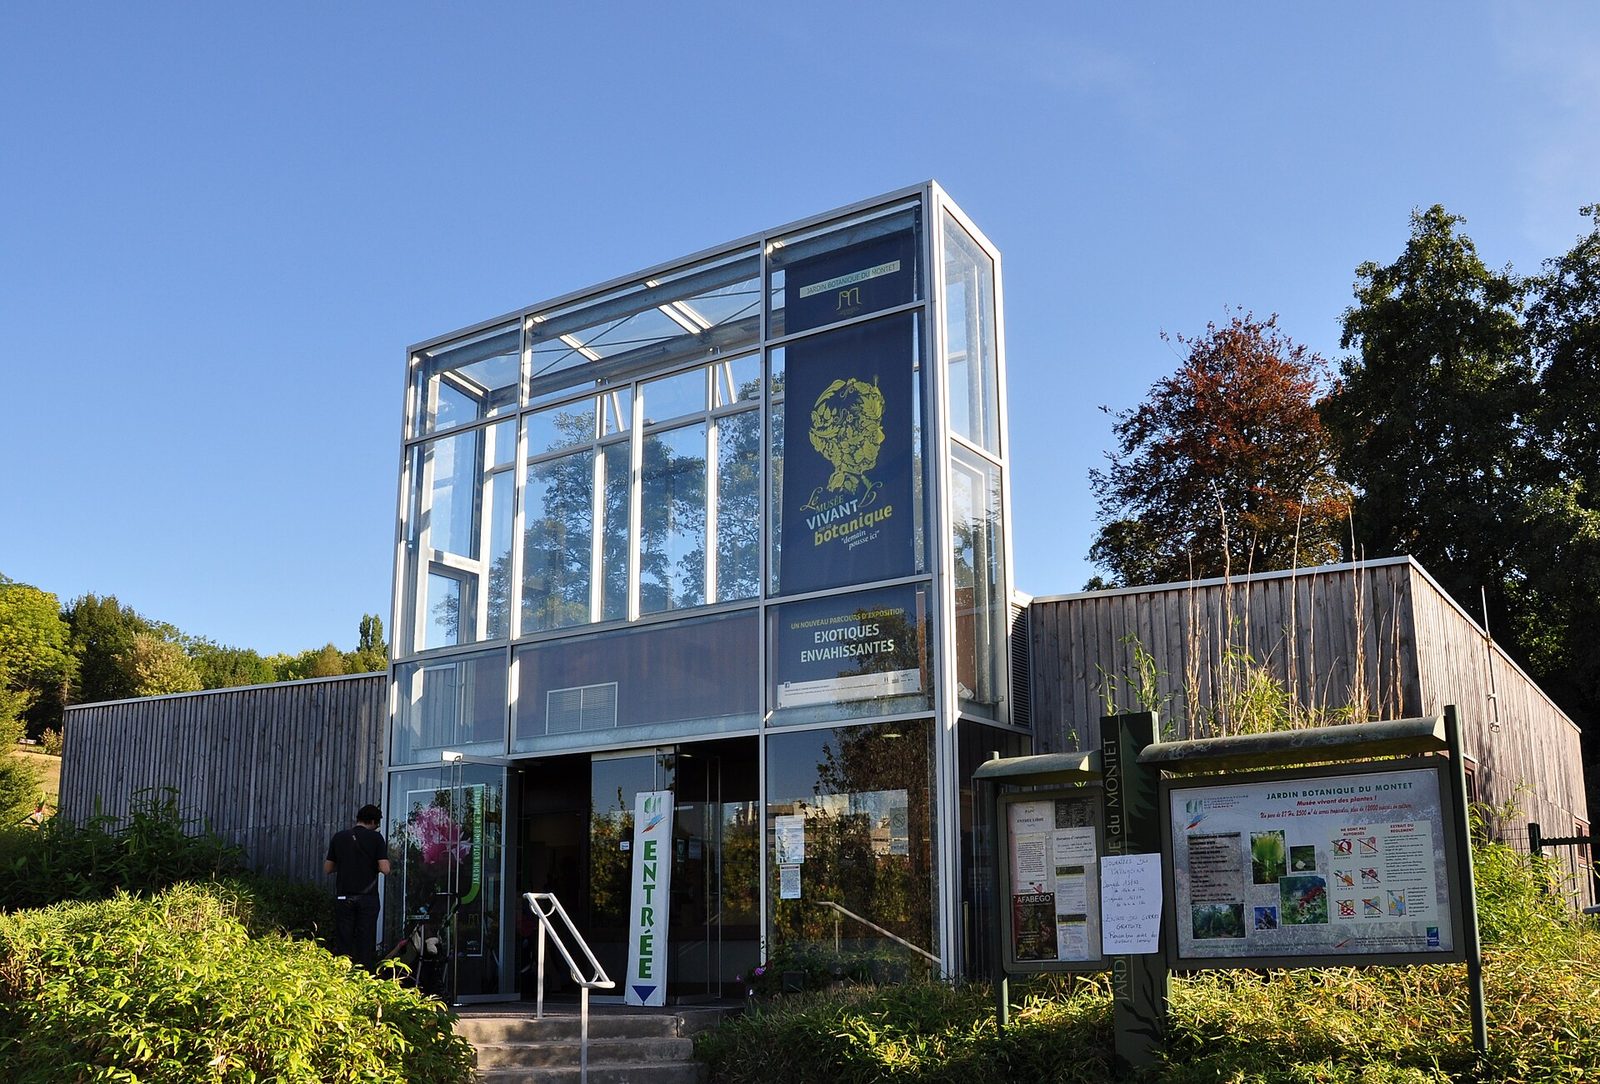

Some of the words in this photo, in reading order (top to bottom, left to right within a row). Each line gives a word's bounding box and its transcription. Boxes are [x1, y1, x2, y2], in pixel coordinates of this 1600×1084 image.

[806, 284, 827, 294] JARDIN
[828, 274, 860, 289] BOTANIQUE
[872, 264, 896, 276] MONTET
[806, 499, 858, 530] VIVANT
[814, 504, 893, 546] botanique
[848, 538, 869, 551] pousse
[800, 618, 829, 628] NOUVEAU
[829, 614, 861, 624] PARCOURS
[862, 608, 904, 620] D'EXPOSITION
[814, 623, 880, 644] EXOTIQUES
[800, 639, 895, 663] ENVAHISSANTES
[1104, 738, 1119, 808] MONTET
[1266, 792, 1298, 800] JARDIN
[1302, 787, 1354, 797] BOTANIQUE
[1375, 782, 1412, 791] MONTET
[1107, 815, 1120, 834] du
[638, 840, 657, 979] ENTRÉE
[1016, 895, 1051, 903] AFABEGO
